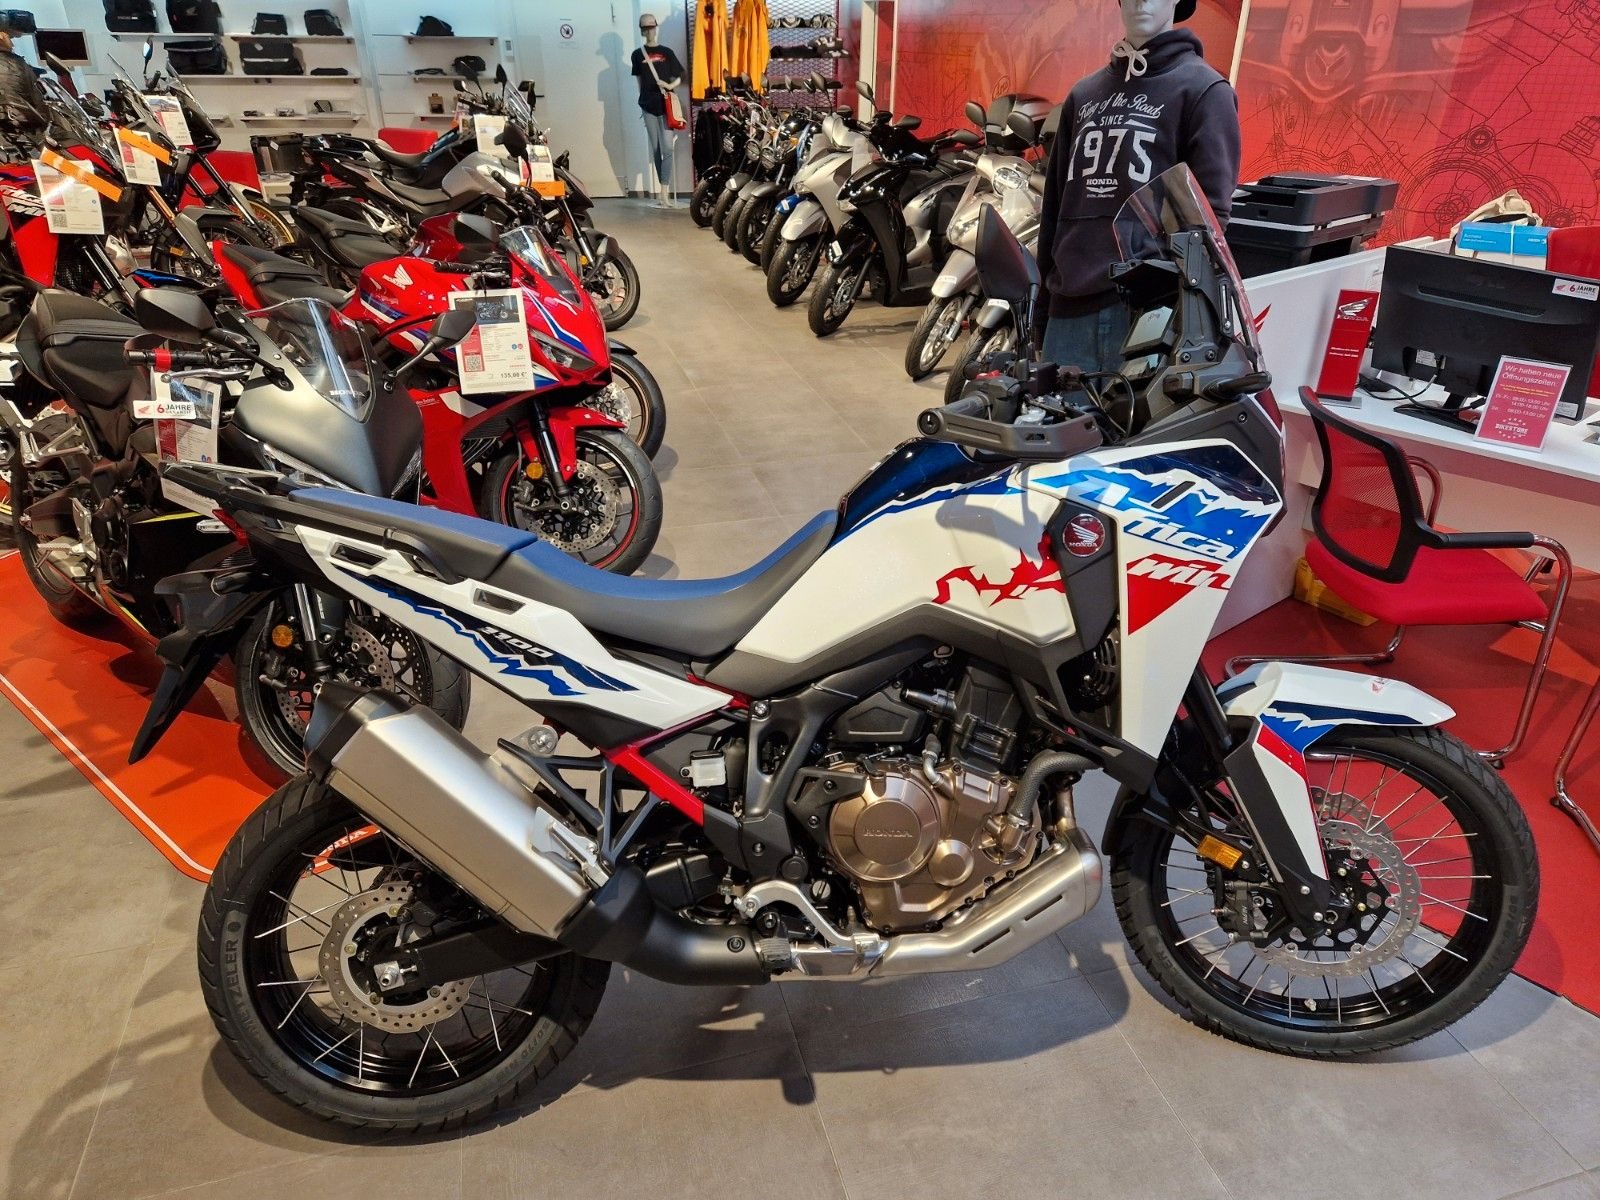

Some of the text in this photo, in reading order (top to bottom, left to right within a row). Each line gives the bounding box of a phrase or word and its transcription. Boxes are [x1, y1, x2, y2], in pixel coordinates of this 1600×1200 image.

[1077, 92, 1165, 123] King of the Road
[1100, 115, 1125, 126] SINCE
[1067, 128, 1157, 184] 1975
[1086, 178, 1118, 186] HONDA
[1569, 283, 1597, 293] 6 JAHRE
[1505, 364, 1562, 379] Wir haben neue
[157, 404, 165, 413] 6
[1495, 423, 1528, 434] BIKESTORE
[478, 626, 554, 658] 1100
[863, 827, 913, 838] HONDA
